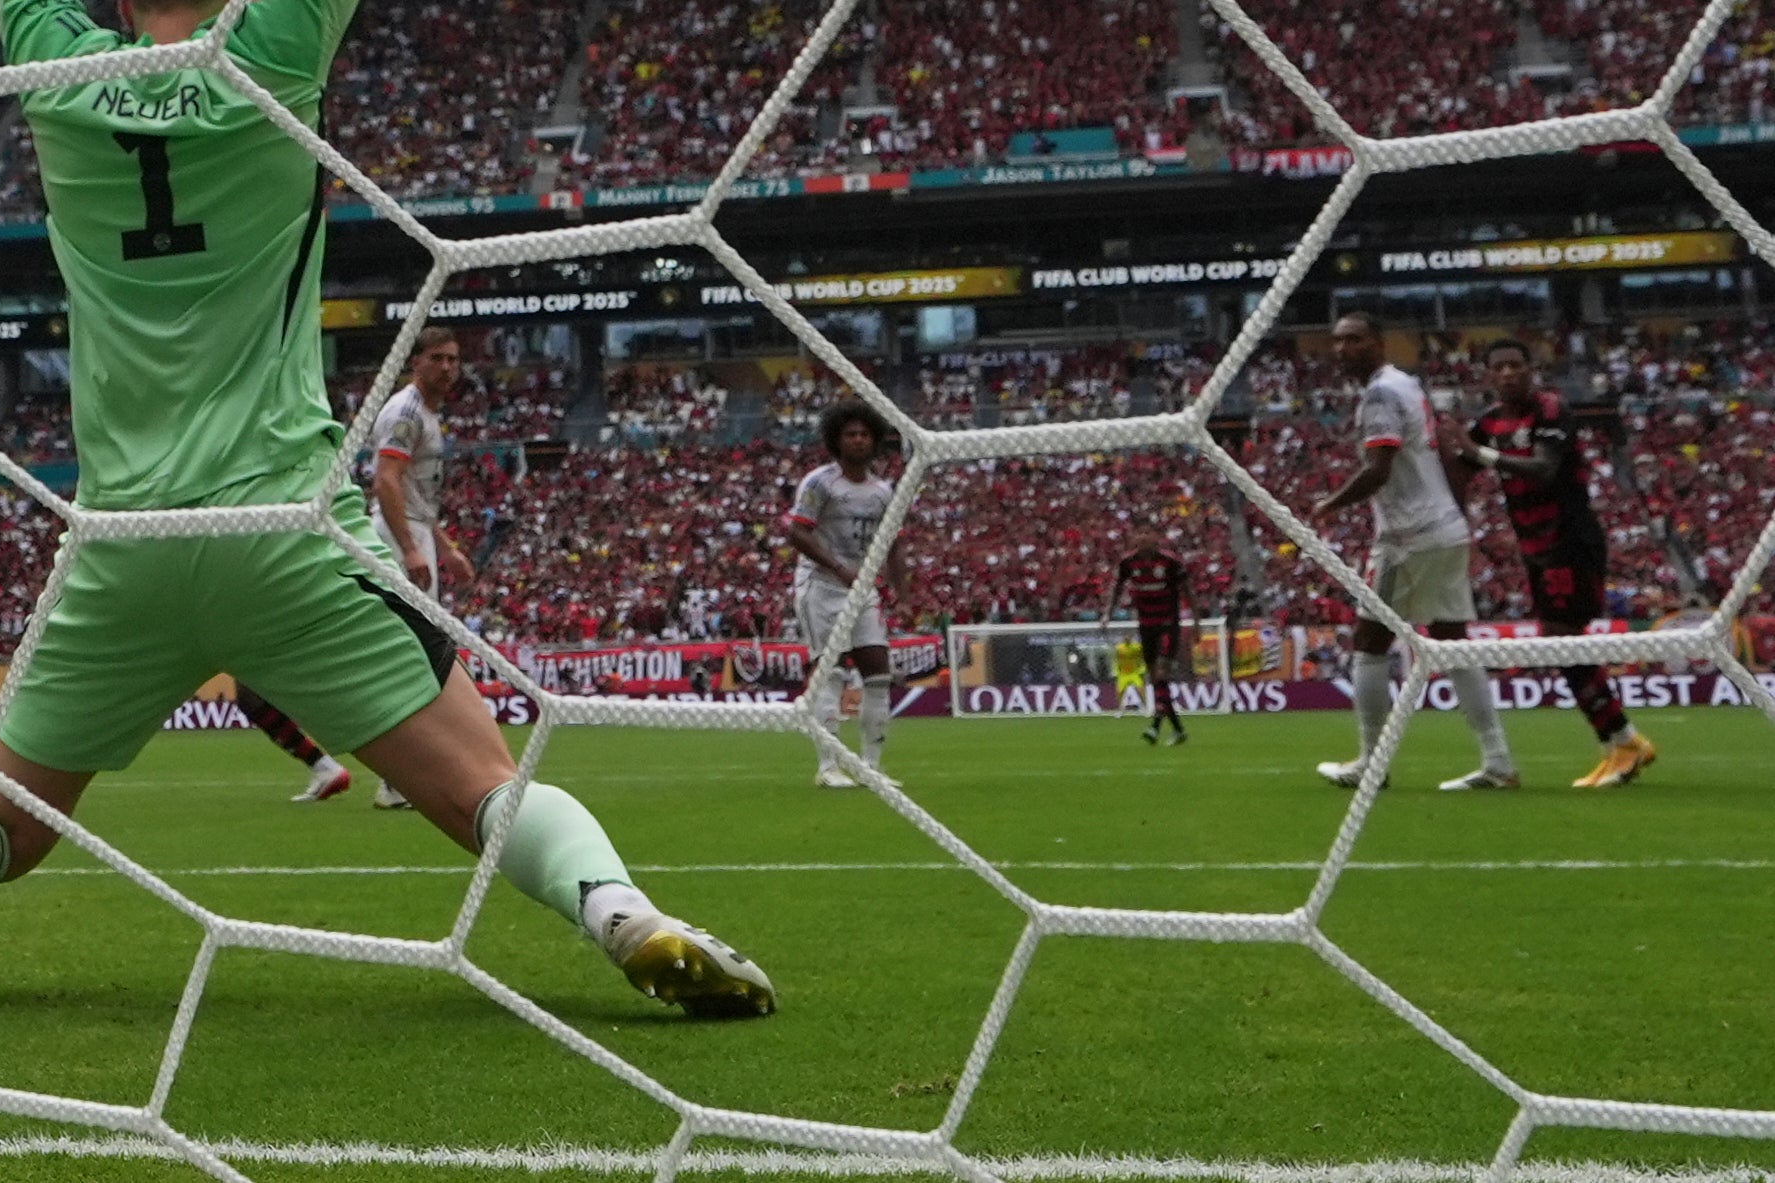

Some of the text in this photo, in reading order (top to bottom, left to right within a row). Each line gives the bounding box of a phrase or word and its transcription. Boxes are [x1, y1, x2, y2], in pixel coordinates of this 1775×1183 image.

[92, 84, 200, 121] NEUER
[112, 130, 207, 262] 1
[1381, 252, 1426, 272] FIFA
[1428, 249, 1482, 270] CLUB
[1484, 246, 1562, 267] WORLD
[1564, 243, 1608, 263] CUP
[1032, 269, 1074, 289] FIFA
[1076, 266, 1128, 287] CLUB
[1130, 263, 1204, 284] WORLD
[1206, 260, 1248, 280] CUP
[475, 296, 541, 315] WORLD
[542, 293, 580, 312] CUP
[701, 286, 742, 305] FIFA
[795, 279, 863, 300] WORLD
[865, 277, 906, 297] CUP
[970, 683, 1102, 714] QATAR
